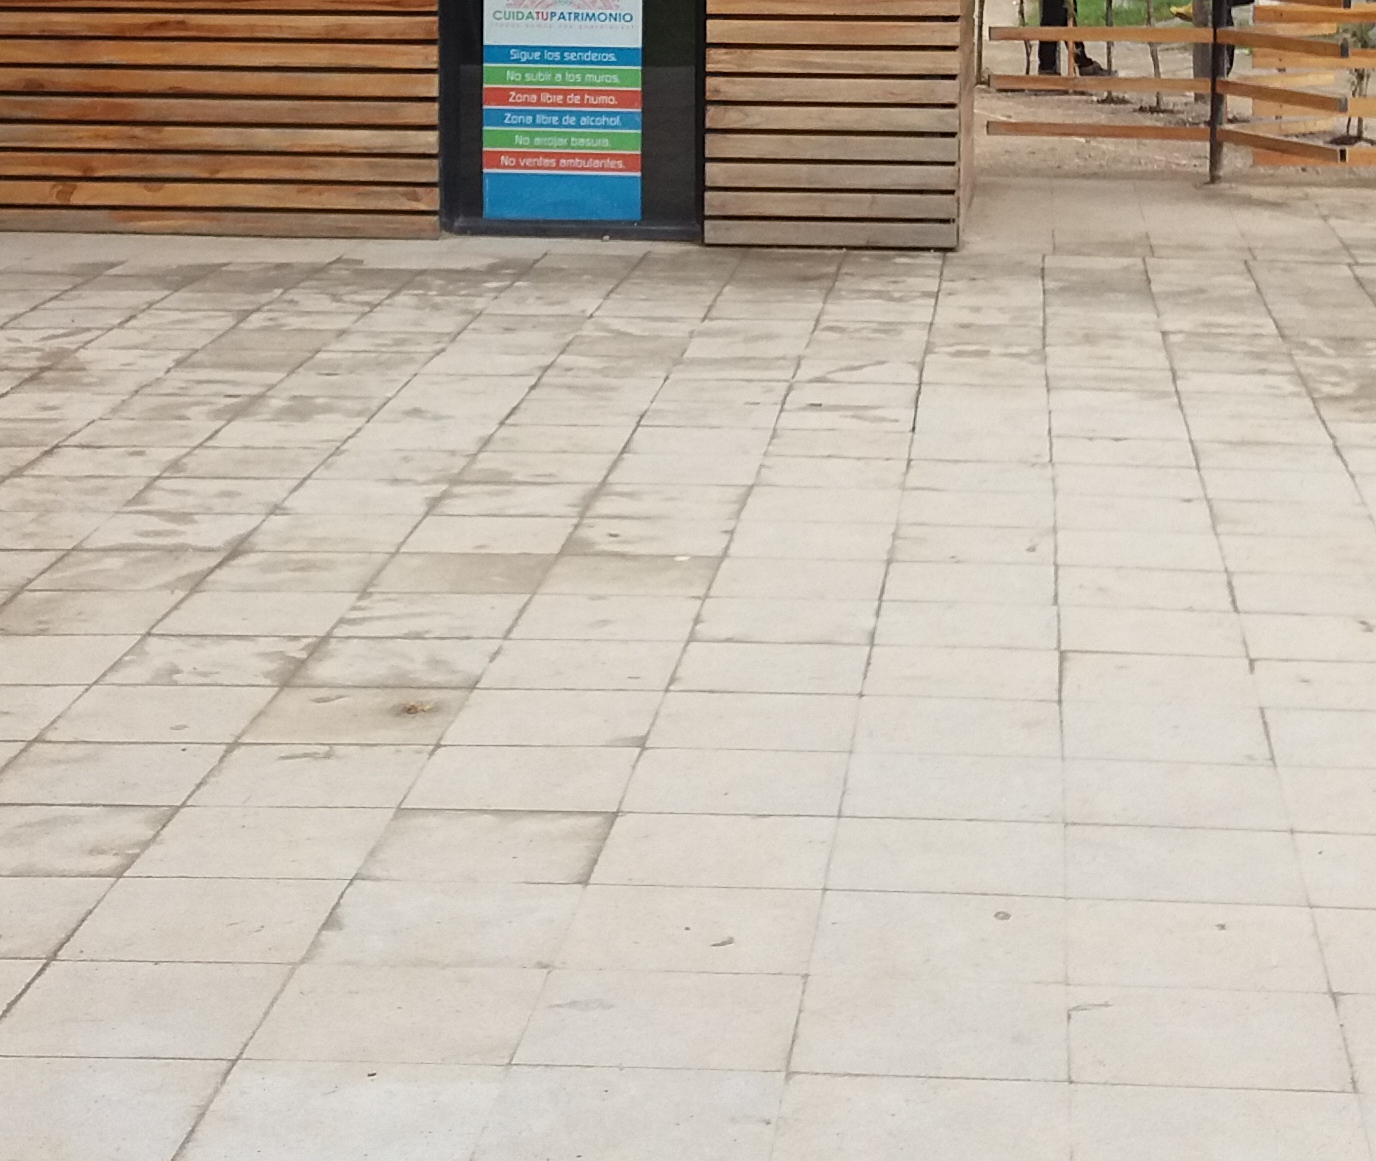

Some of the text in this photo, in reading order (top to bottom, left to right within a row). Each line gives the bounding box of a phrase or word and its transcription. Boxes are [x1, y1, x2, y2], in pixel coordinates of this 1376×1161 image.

[492, 10, 634, 23] CUIDATUPATRIMONIO
[509, 49, 617, 61] Sigue los senderos.
[506, 70, 621, 83] No subir a los muros.
[508, 91, 618, 104] Zona libre de humo.
[503, 113, 622, 126] Zona libre de alcohol.
[514, 135, 530, 146] No
[533, 136, 568, 147] arrojar
[500, 155, 626, 168] No ventas ambulantes.
